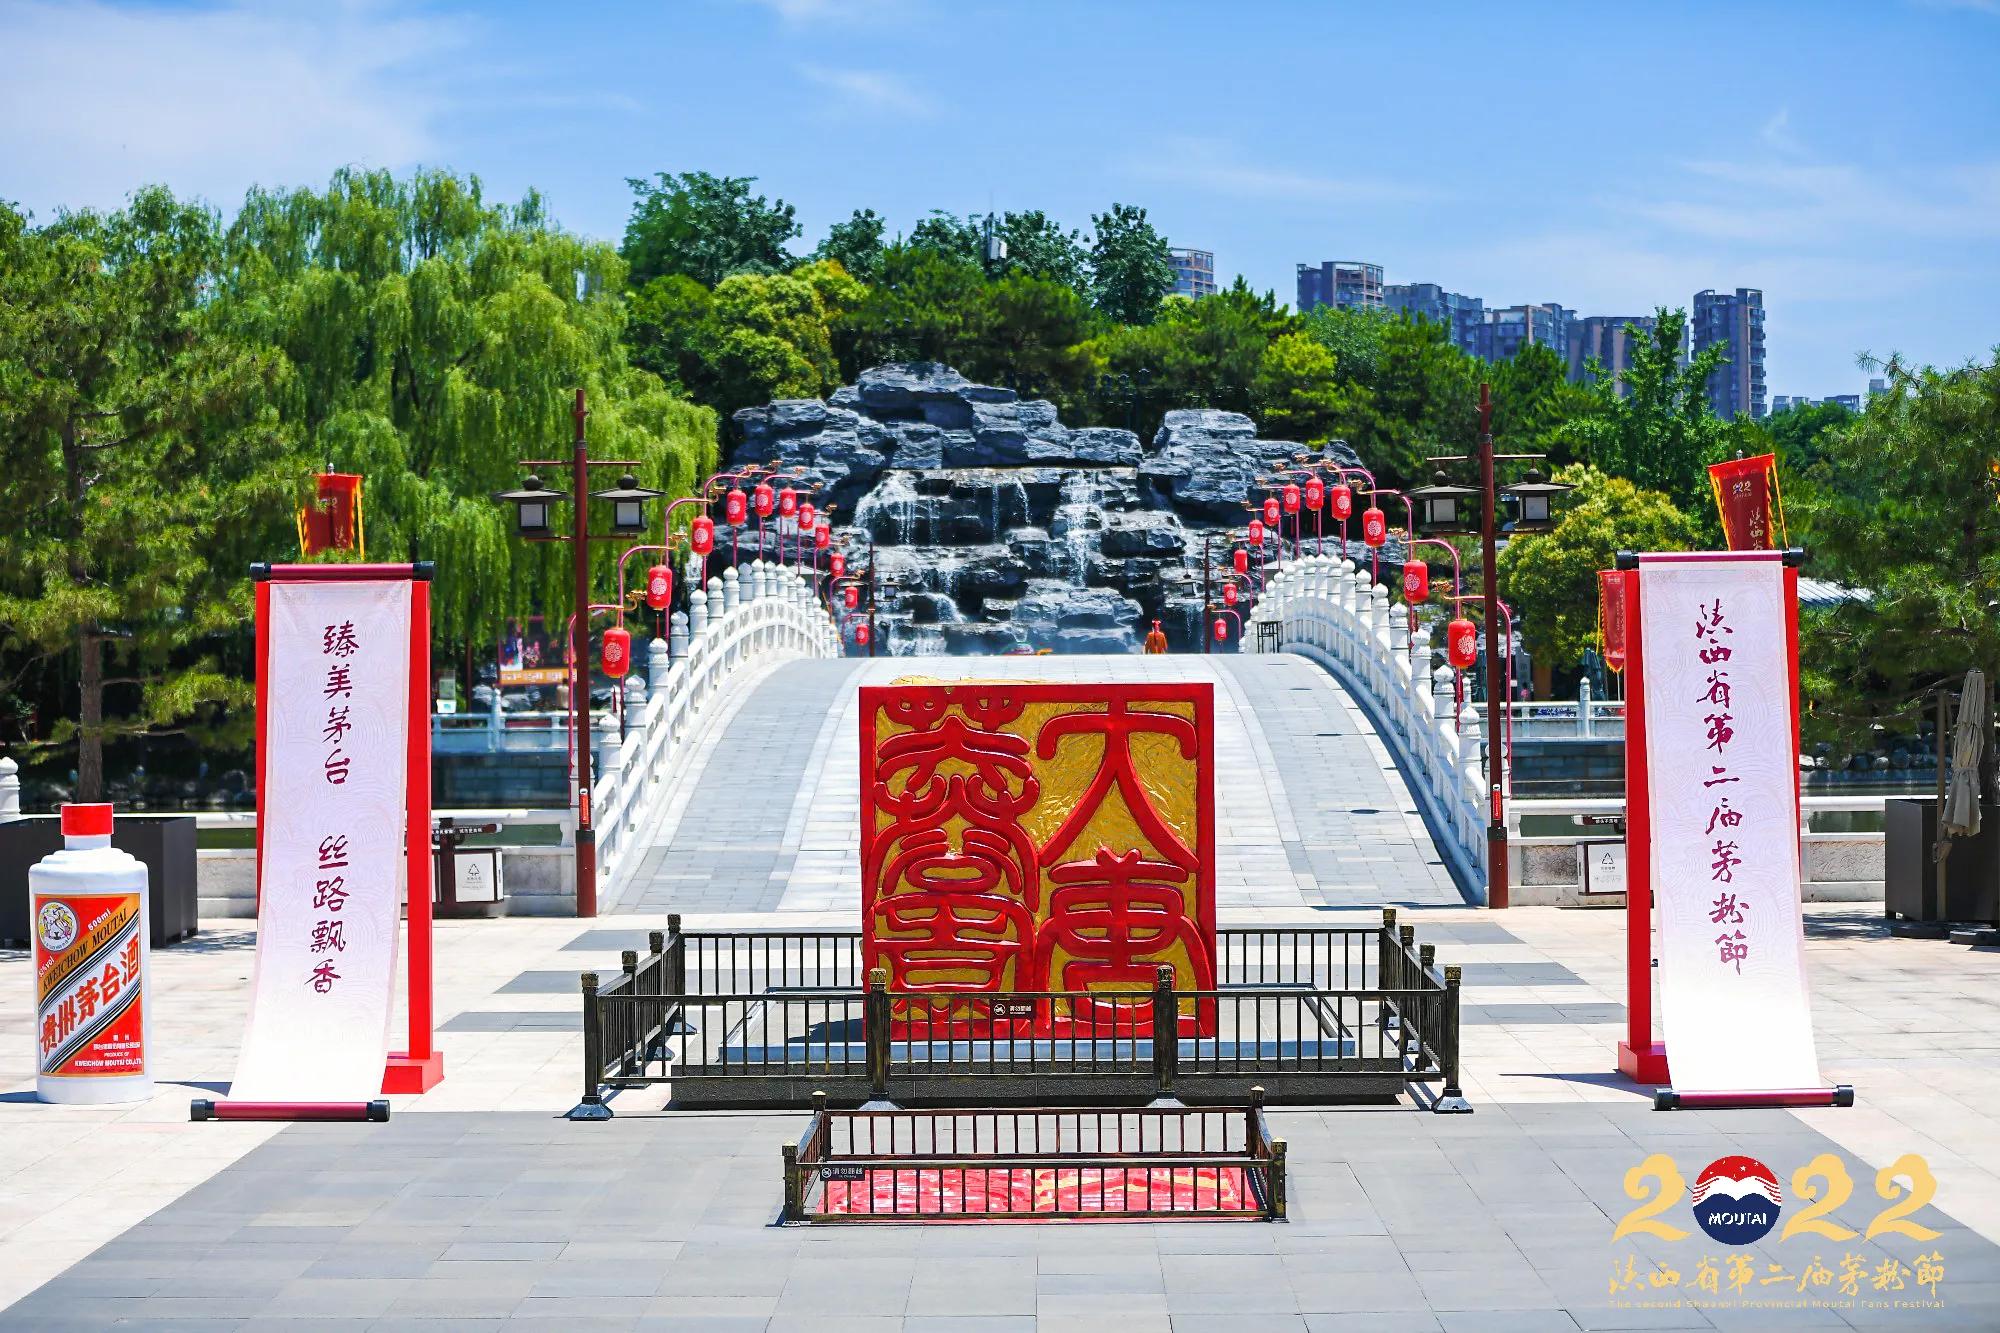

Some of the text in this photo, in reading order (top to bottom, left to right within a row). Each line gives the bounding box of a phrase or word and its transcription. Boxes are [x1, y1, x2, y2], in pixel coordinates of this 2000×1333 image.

[304, 619, 360, 994] 臻美茅台 丝路飘香
[41, 907, 128, 993] KWEICHOW MOUTAI
[87, 908, 112, 931] 500ml
[40, 932, 140, 1060] 贵州茅台酒
